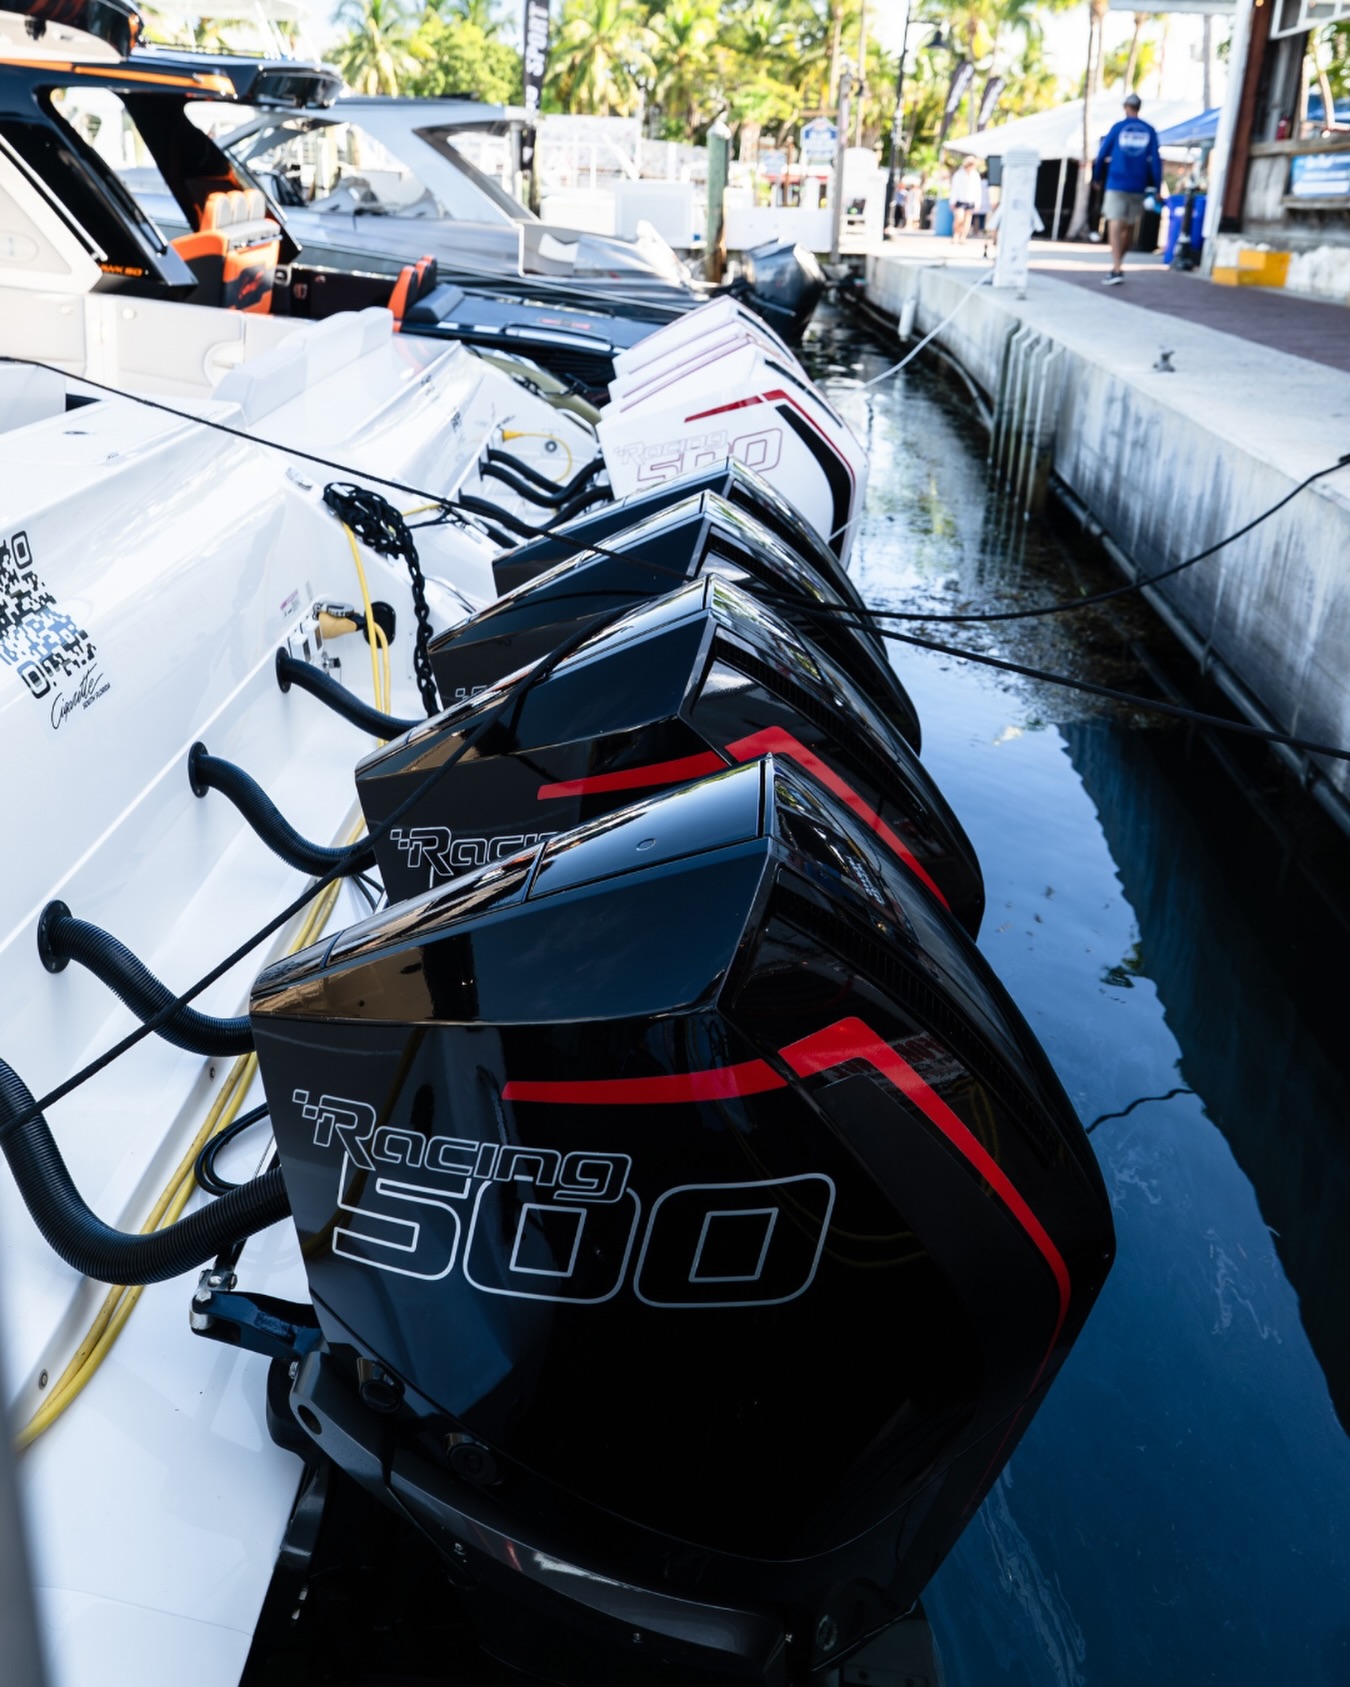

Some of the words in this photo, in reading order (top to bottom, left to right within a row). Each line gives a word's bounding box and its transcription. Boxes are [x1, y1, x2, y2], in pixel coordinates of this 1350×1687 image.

[525, 1, 548, 77] SPORT
[612, 429, 728, 467] Racing
[292, 1088, 632, 1203] Racing
[332, 1150, 837, 1308] 500
